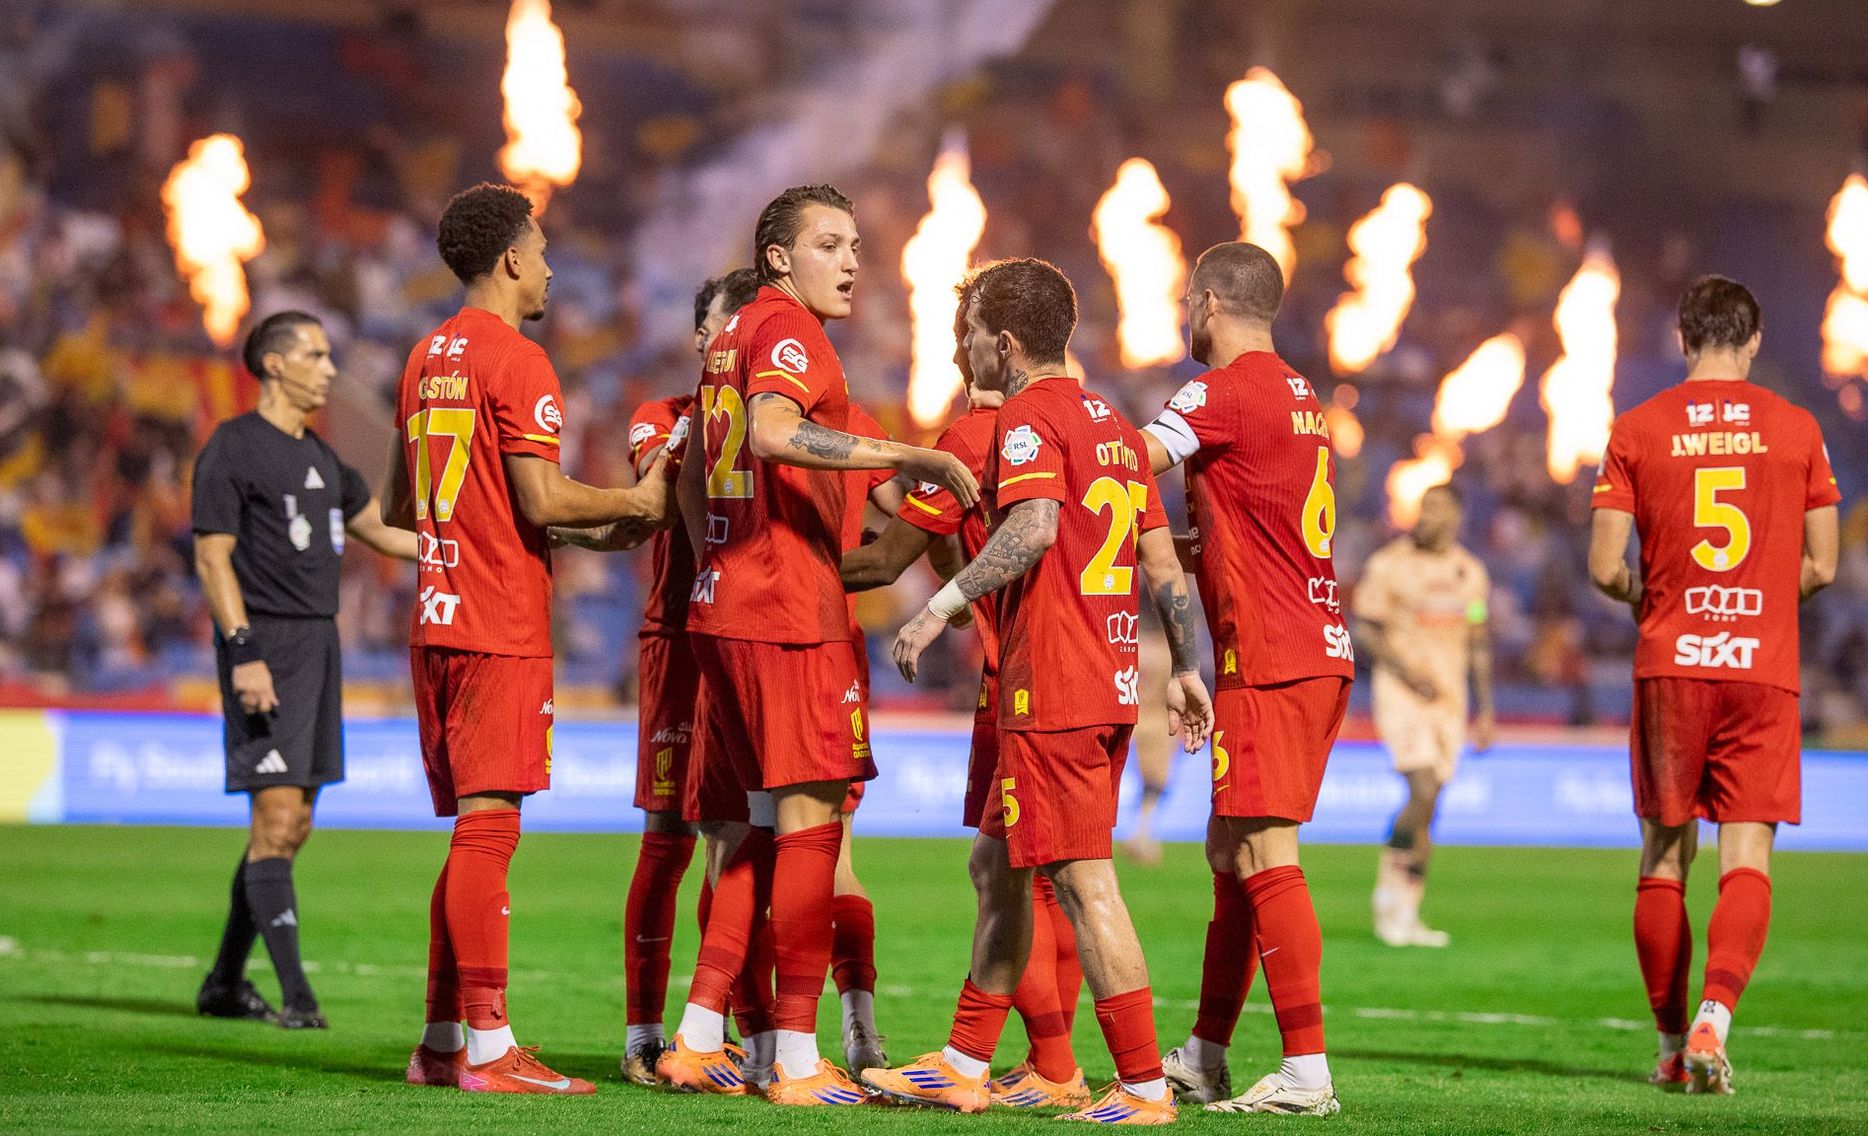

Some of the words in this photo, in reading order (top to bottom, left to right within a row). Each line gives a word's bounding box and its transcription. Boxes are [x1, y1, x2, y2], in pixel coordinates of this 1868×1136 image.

[1671, 431, 1769, 457] J.WEIGL
[1301, 445, 1336, 559] 6
[1690, 466, 1752, 573] 5
[1673, 631, 1761, 670] SIXT
[1212, 730, 1230, 781] 6
